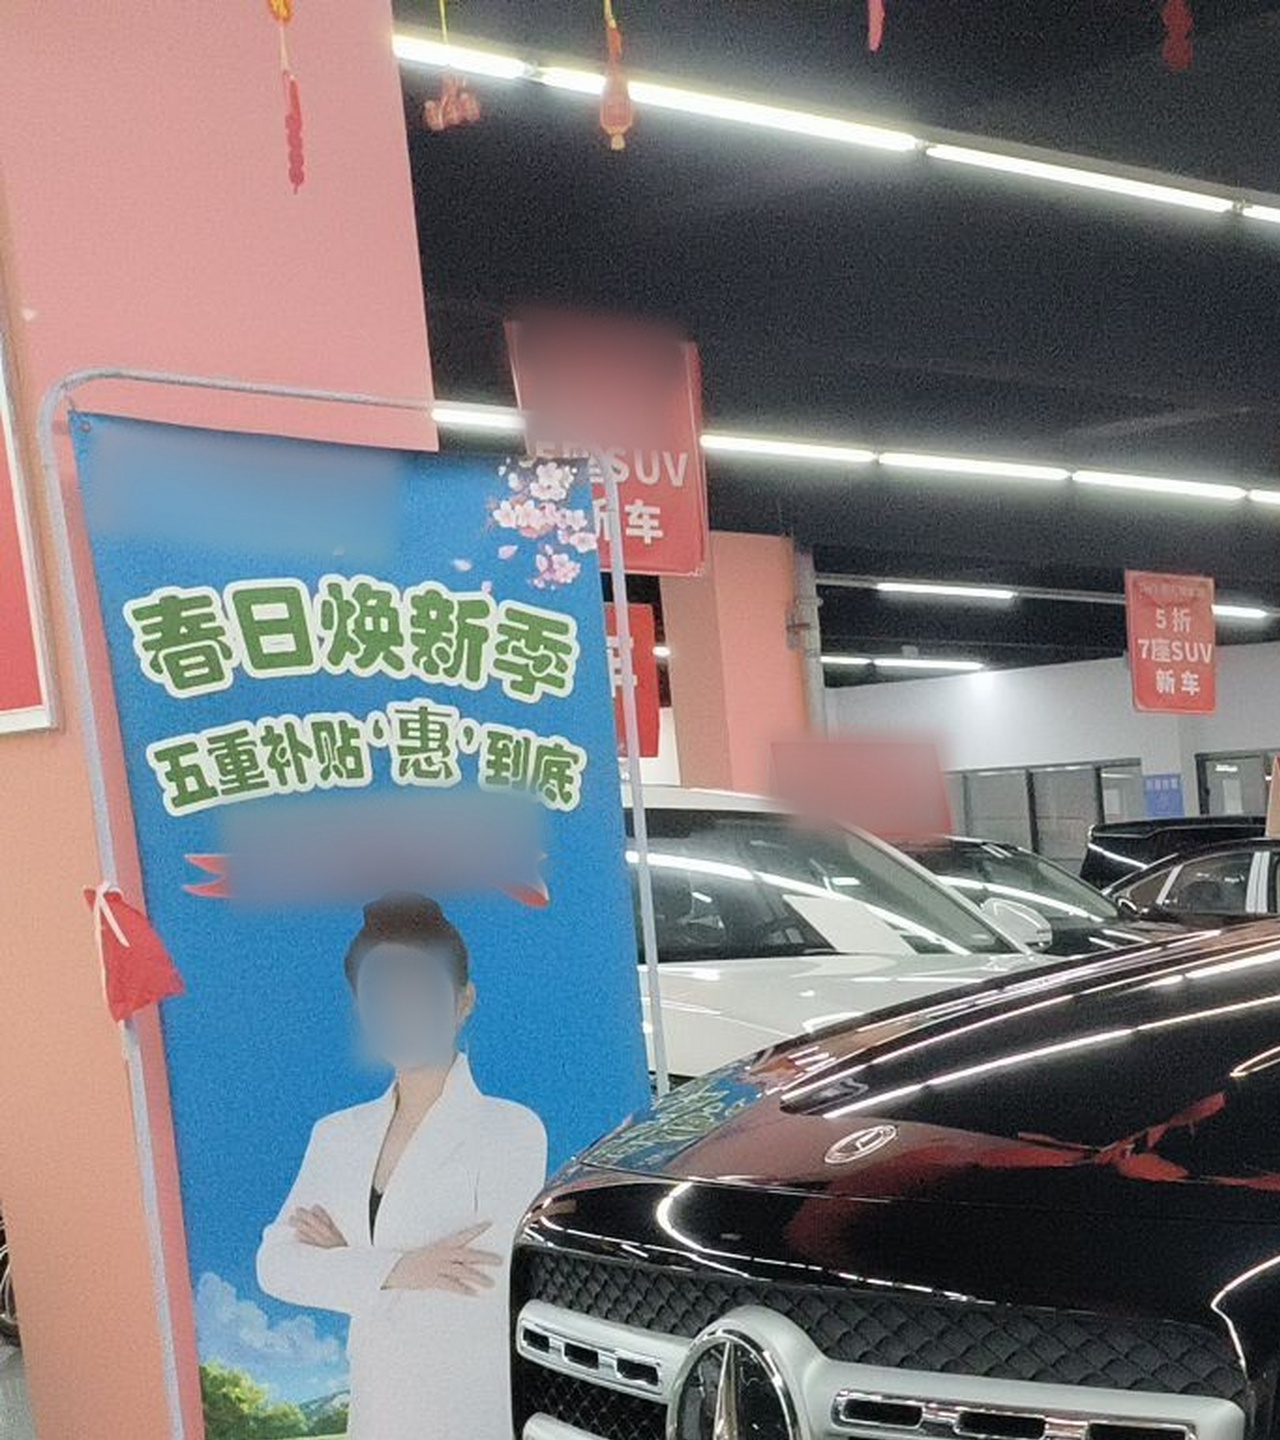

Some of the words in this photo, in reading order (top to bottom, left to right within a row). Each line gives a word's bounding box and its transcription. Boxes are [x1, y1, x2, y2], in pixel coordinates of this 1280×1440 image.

[128, 579, 577, 699] 春日焕新季
[1137, 638, 1213, 664] 7座SUV
